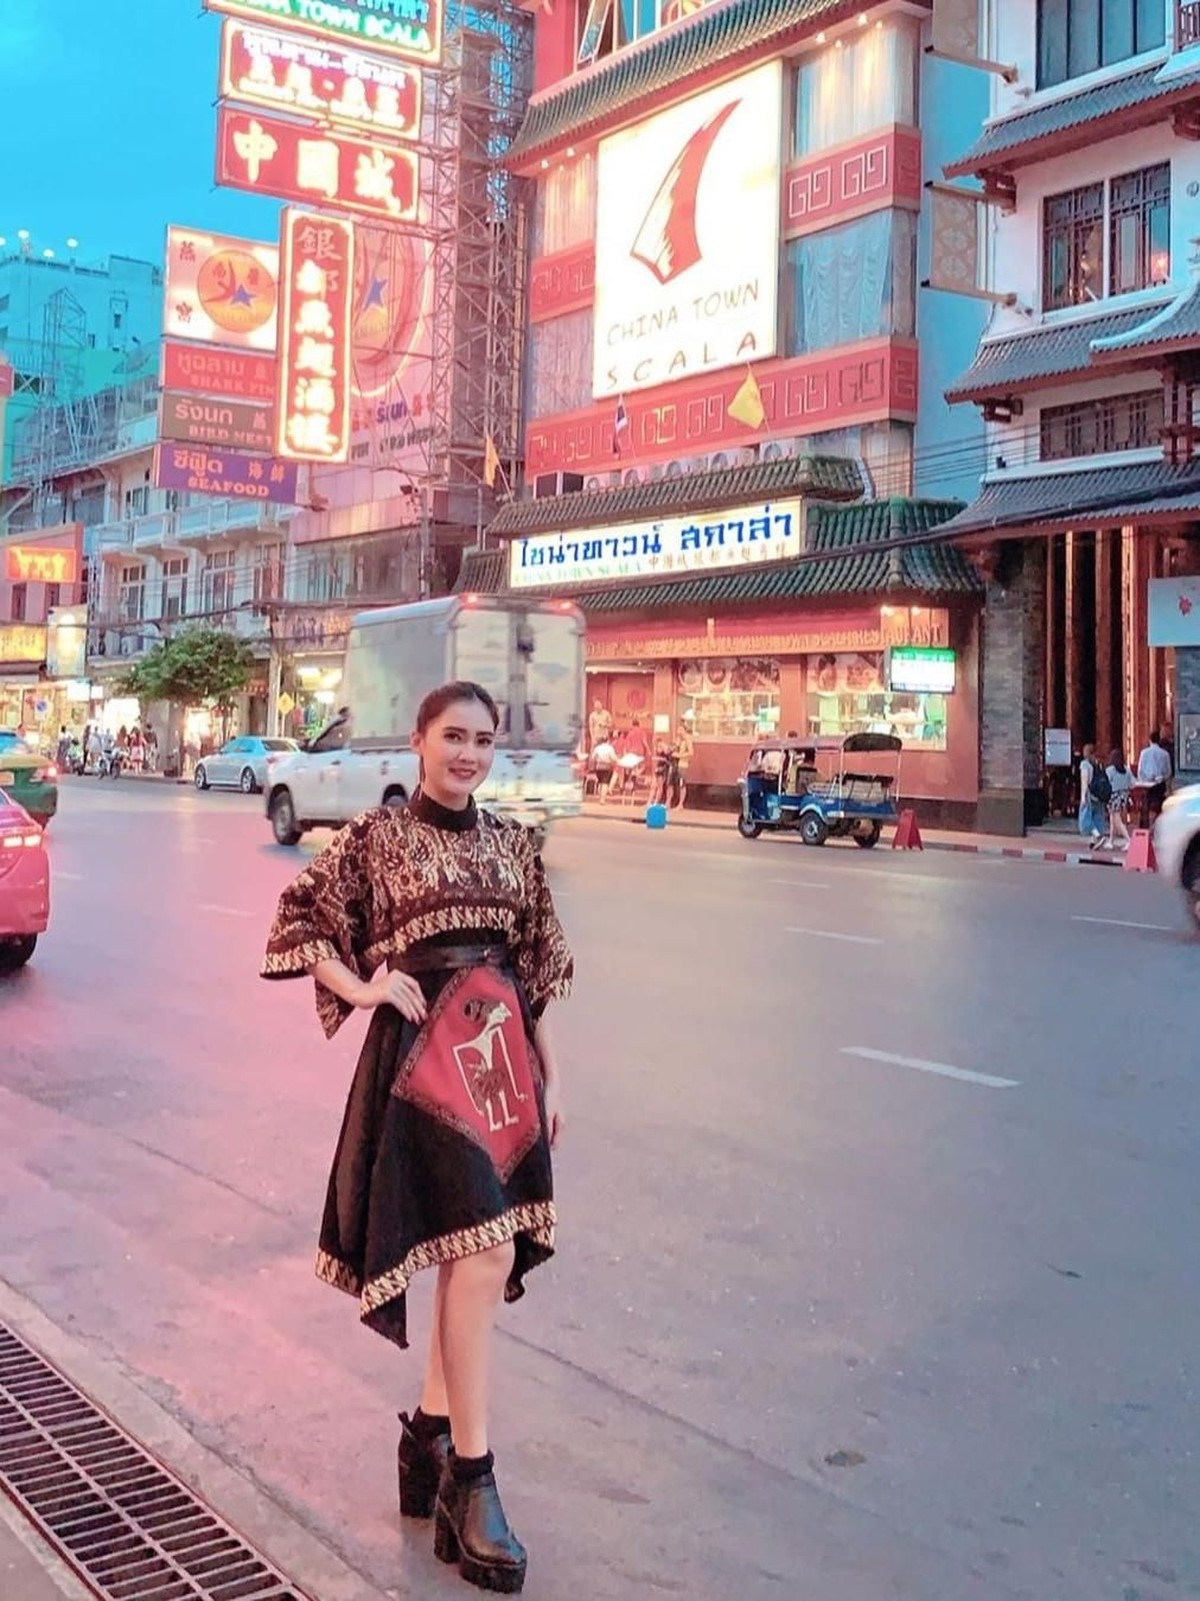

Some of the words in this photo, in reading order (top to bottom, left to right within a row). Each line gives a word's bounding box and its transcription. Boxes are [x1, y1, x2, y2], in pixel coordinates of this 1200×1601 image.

[298, 0, 360, 31] TOWN
[364, 15, 431, 50] SCALA
[606, 304, 679, 347] CHINA
[692, 278, 758, 322] TOWN
[177, 351, 245, 375] หูฉลาม
[605, 331, 757, 391] SCALA
[189, 374, 244, 392] SHARK
[174, 398, 234, 425] รังนก
[189, 425, 230, 440] BIRD
[234, 431, 273, 447] NEST
[188, 476, 270, 497] SEAFOOD
[681, 504, 793, 552] สกาล่า
